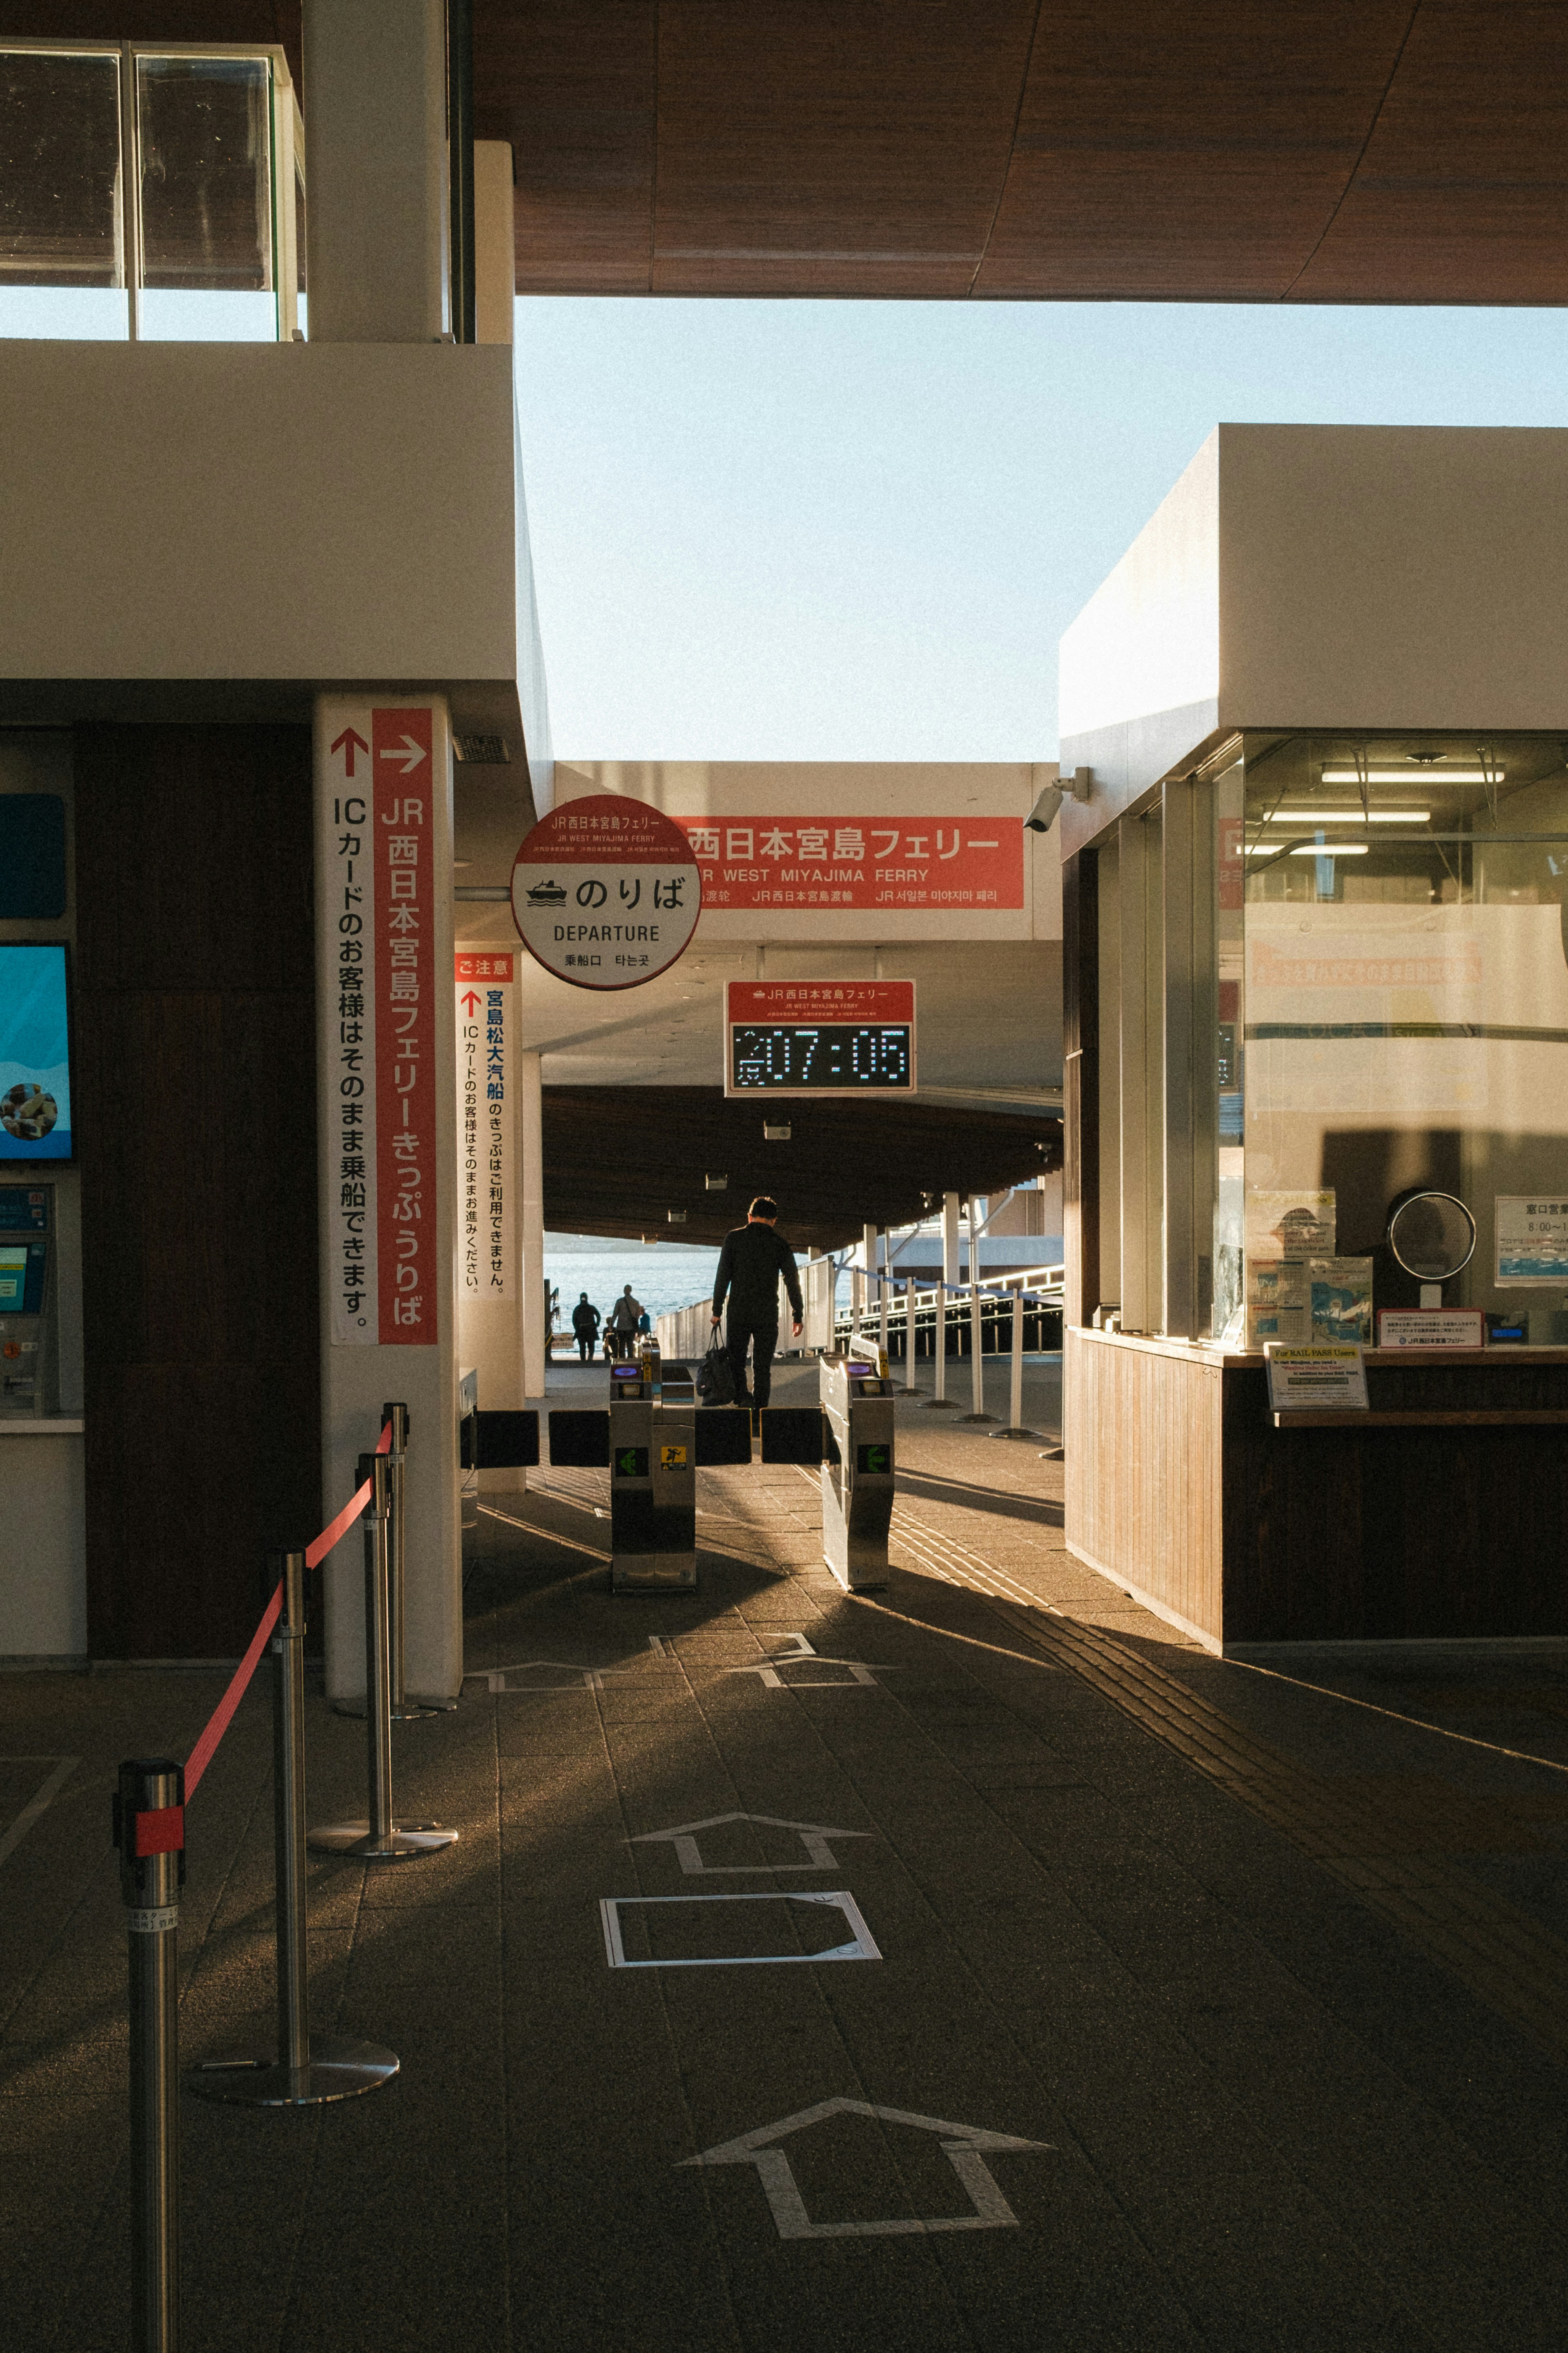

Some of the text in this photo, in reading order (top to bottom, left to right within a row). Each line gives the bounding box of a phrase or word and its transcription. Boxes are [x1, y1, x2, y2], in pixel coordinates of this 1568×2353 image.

[552, 816, 659, 830] JR西日本宮島フェリー
[724, 869, 770, 881] WEST
[781, 869, 864, 881] MIYAJIMA
[875, 869, 929, 881] FERRY
[576, 877, 686, 910] のりば
[752, 890, 853, 902] JR西日本宮島渡輪
[876, 890, 997, 902] JR 서일본 미야지마 페리
[555, 926, 659, 941] DEPARTURE
[565, 954, 601, 966] 乗船口
[615, 955, 649, 966] 타는곳
[460, 960, 508, 975] ご注意
[768, 989, 888, 999] JR西日本宮島フェリー
[334, 798, 366, 1327] ICカードのお客様はそのまま乗船できます。
[382, 798, 423, 1326] JR西日本宮島フェリーきっぷうりば
[464, 1026, 479, 1293] ICカードのお客様はそのままお進みください。
